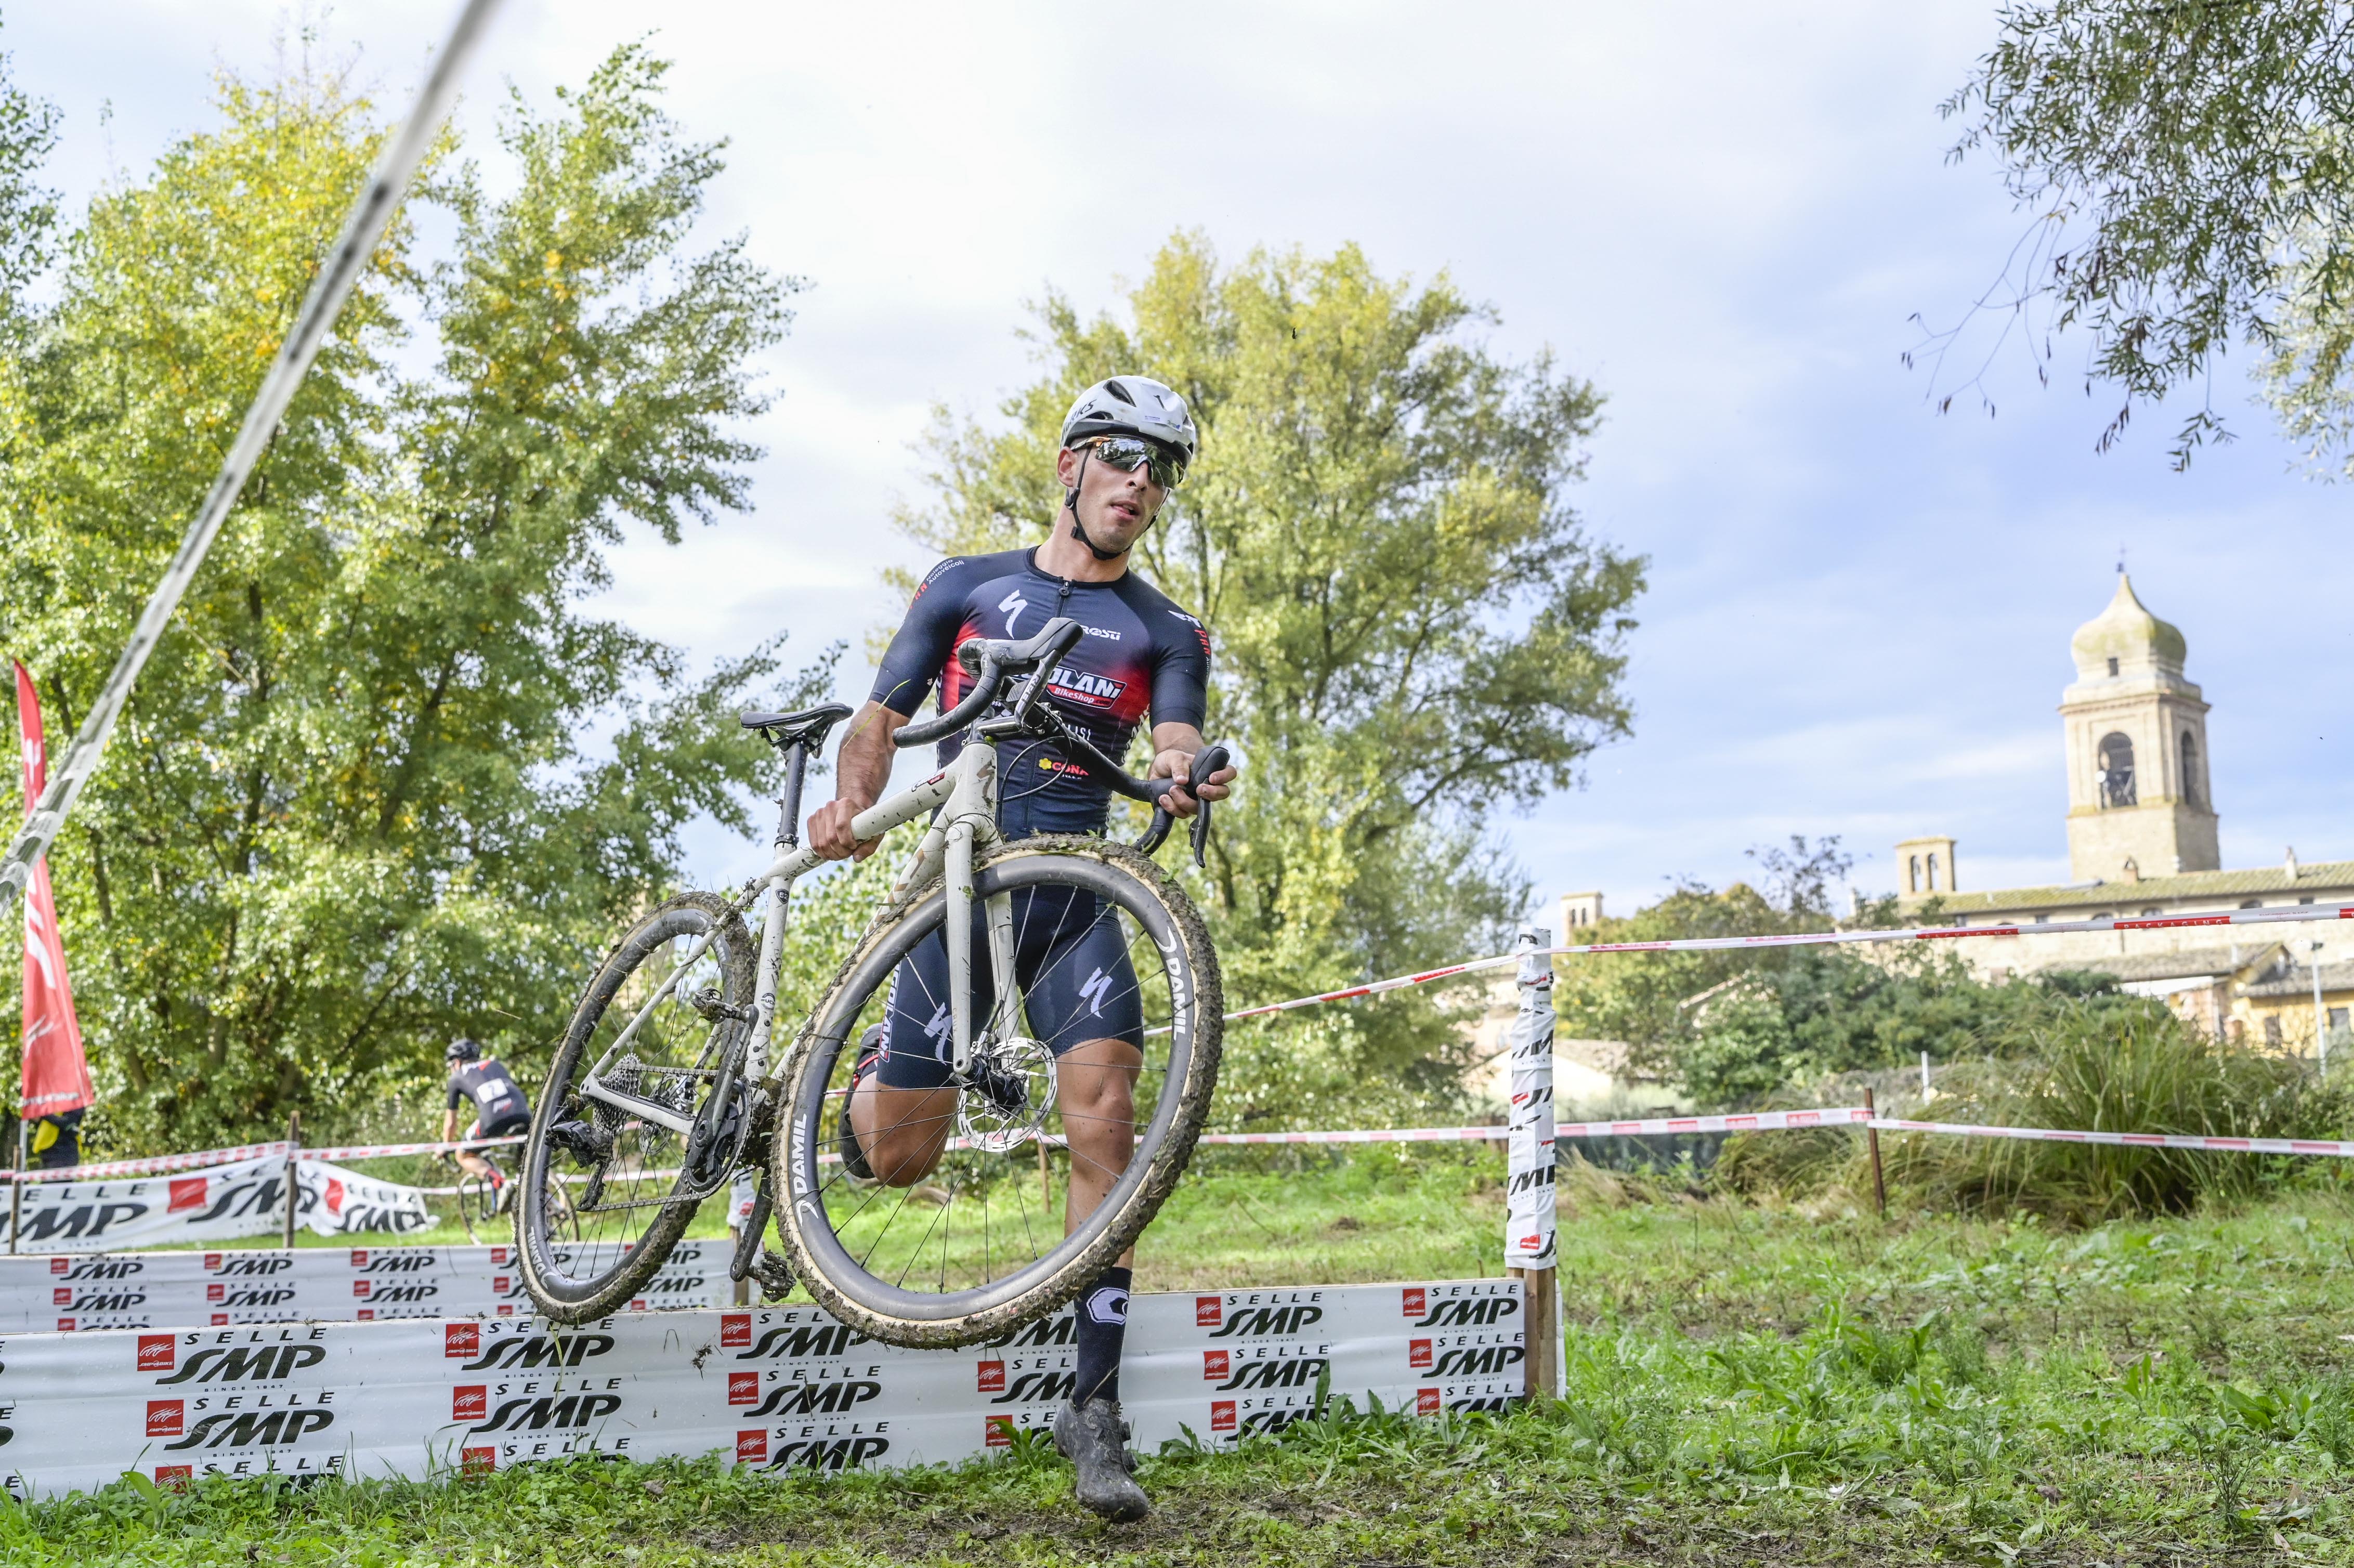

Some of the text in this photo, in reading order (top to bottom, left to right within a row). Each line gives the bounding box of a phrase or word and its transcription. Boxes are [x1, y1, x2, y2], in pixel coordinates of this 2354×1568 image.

[926, 559, 953, 582] Noleggio
[928, 560, 965, 585] Autoveicoli
[1194, 629, 1211, 656] PAN
[1052, 762, 1090, 776] CONA
[2124, 919, 2222, 929] PACKAGING
[1166, 957, 1186, 1041] DAMIL
[792, 1113, 808, 1194] DAMIL
[0, 1183, 148, 1201] ELLE
[527, 1226, 546, 1276] DAMIL
[59, 1262, 144, 1280] SMP
[213, 1259, 293, 1275] SMP
[359, 1256, 435, 1272] SMP
[77, 1285, 147, 1293] SELLE
[639, 1277, 704, 1293] SMP
[1431, 1285, 1518, 1297] SELLE
[62, 1293, 146, 1312] SMP
[216, 1290, 296, 1307] SMP
[362, 1286, 438, 1303] SMP
[1227, 1292, 1322, 1305] SELLE
[81, 1315, 151, 1324] SELLE
[759, 1312, 823, 1324] SEL
[1414, 1298, 1519, 1327] SMP
[1209, 1306, 1323, 1338] SMP
[185, 1328, 326, 1345] SELLE
[736, 1326, 872, 1360] SMP
[1437, 1332, 1524, 1347] SELLE
[461, 1335, 615, 1371] SMP
[1235, 1345, 1329, 1358] SELLE
[155, 1344, 326, 1385] SMP
[1012, 1357, 1070, 1370] SEL
[1421, 1346, 1524, 1378] SMP
[766, 1366, 881, 1381] SELLE
[1215, 1358, 1329, 1391] SMP
[495, 1378, 622, 1395] SELLE
[990, 1371, 1077, 1404] SM
[1445, 1384, 1525, 1396] SELL
[193, 1392, 335, 1410] SELLE
[743, 1381, 882, 1417] SMP
[1242, 1394, 1337, 1409] SELLE
[469, 1394, 622, 1433] SMP
[164, 1409, 334, 1451] SMP
[775, 1422, 890, 1439] SELLE
[504, 1438, 631, 1456] SELLE
[753, 1437, 890, 1473] SMP
[202, 1455, 343, 1475] SELLE
